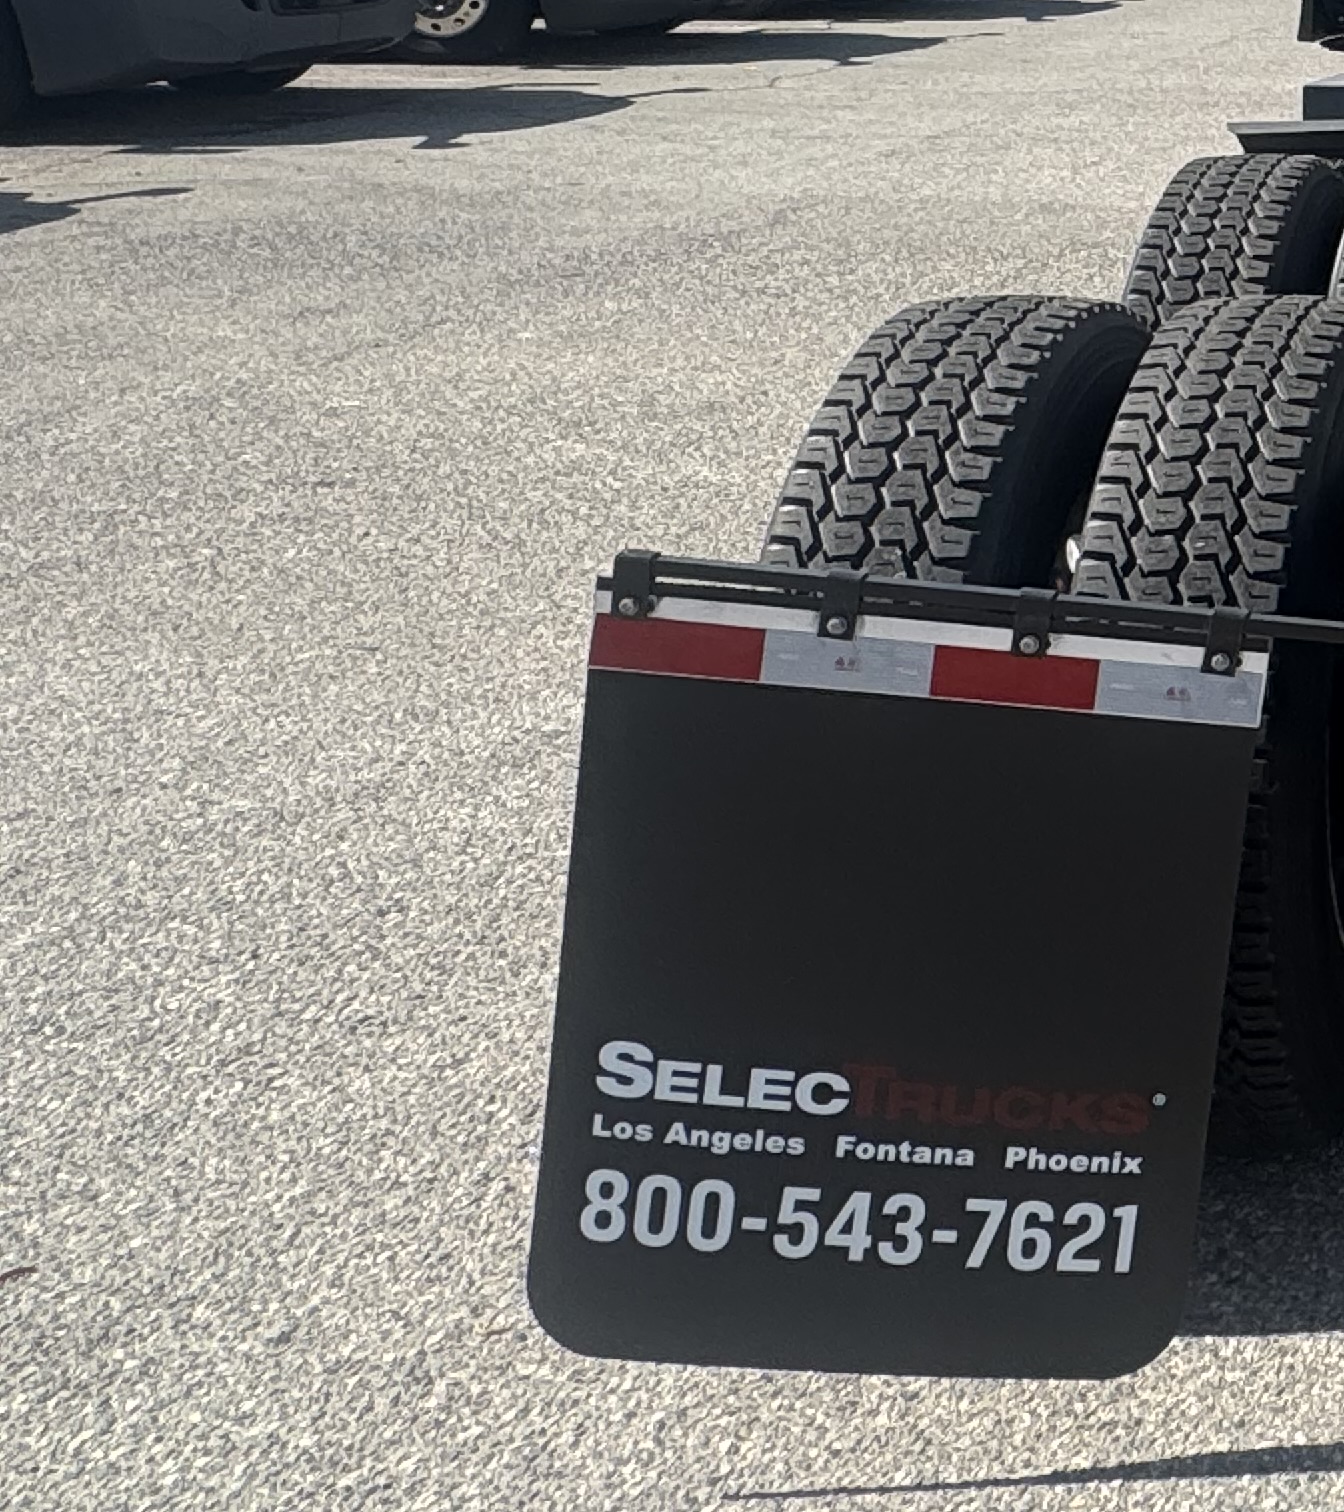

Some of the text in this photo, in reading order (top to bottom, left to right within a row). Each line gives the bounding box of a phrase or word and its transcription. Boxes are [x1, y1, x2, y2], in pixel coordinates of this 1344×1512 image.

[592, 1114, 1143, 1174] Los Angeles Fontana Phoenix
[579, 1168, 1139, 1273] 800-543-7621
